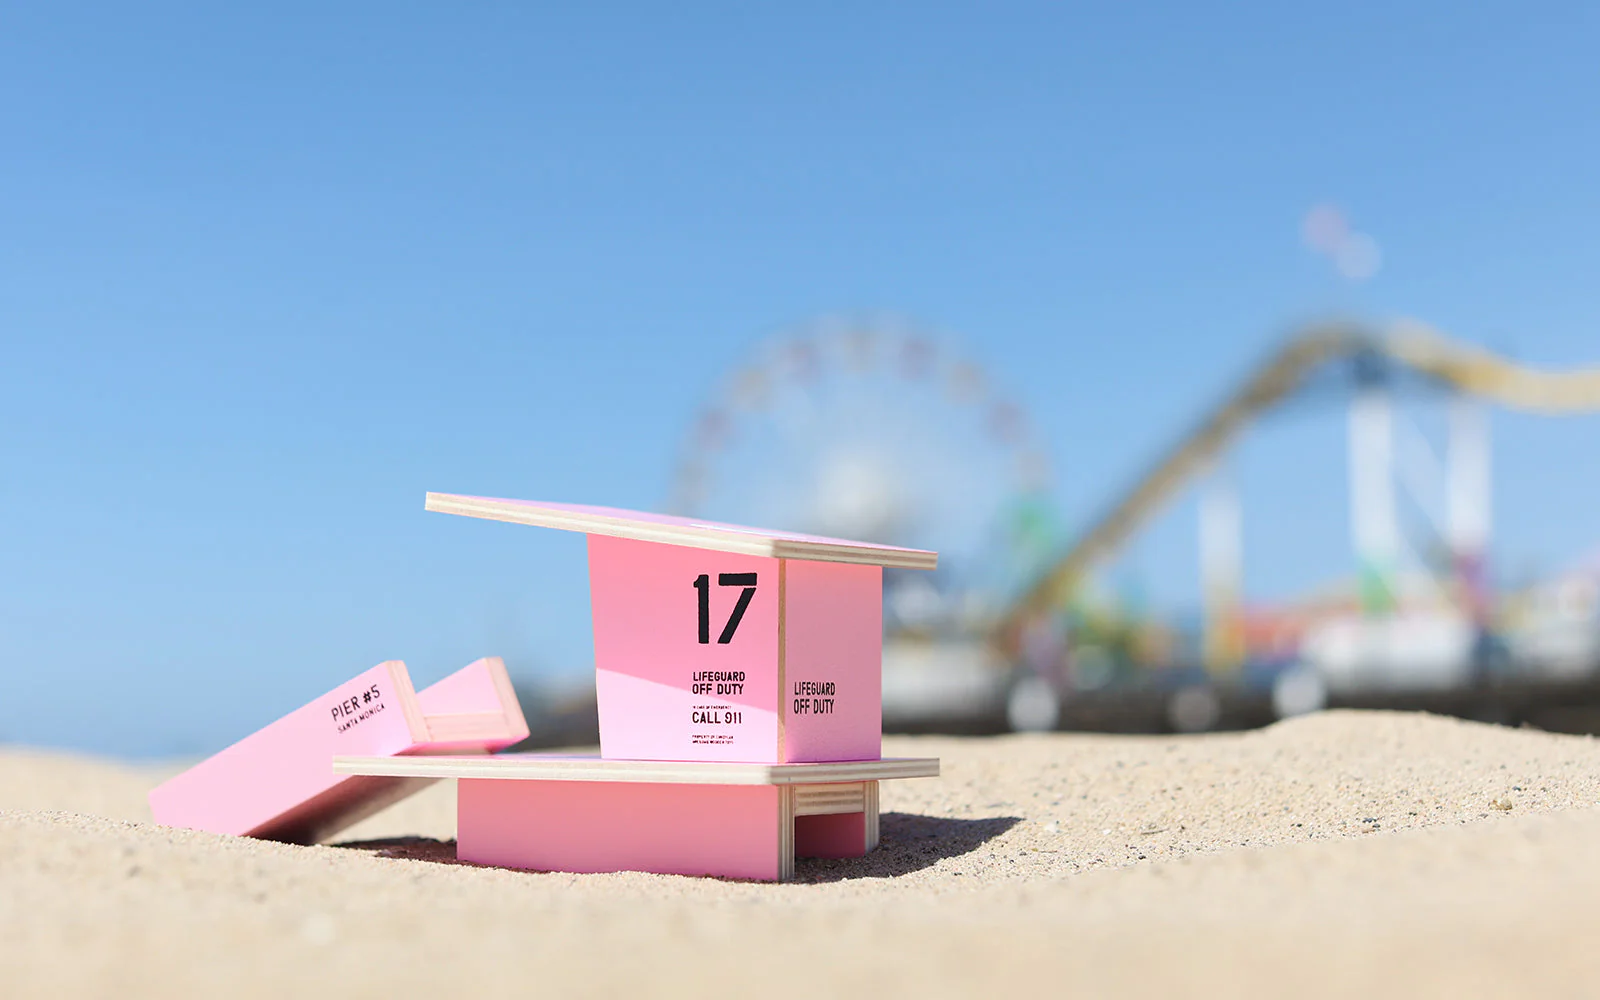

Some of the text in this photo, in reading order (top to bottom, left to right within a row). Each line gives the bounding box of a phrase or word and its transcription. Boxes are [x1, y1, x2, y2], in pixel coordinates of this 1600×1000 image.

[693, 572, 757, 644] 17
[693, 671, 746, 682] LIFEGUARD
[692, 683, 744, 695] OFF DUTY
[794, 682, 836, 696] LIFEGUARD
[331, 684, 380, 722] PIER #5
[793, 699, 835, 714] OFF DUTY
[337, 703, 385, 734] SANTA MONICA
[692, 711, 742, 724] CALL 911
